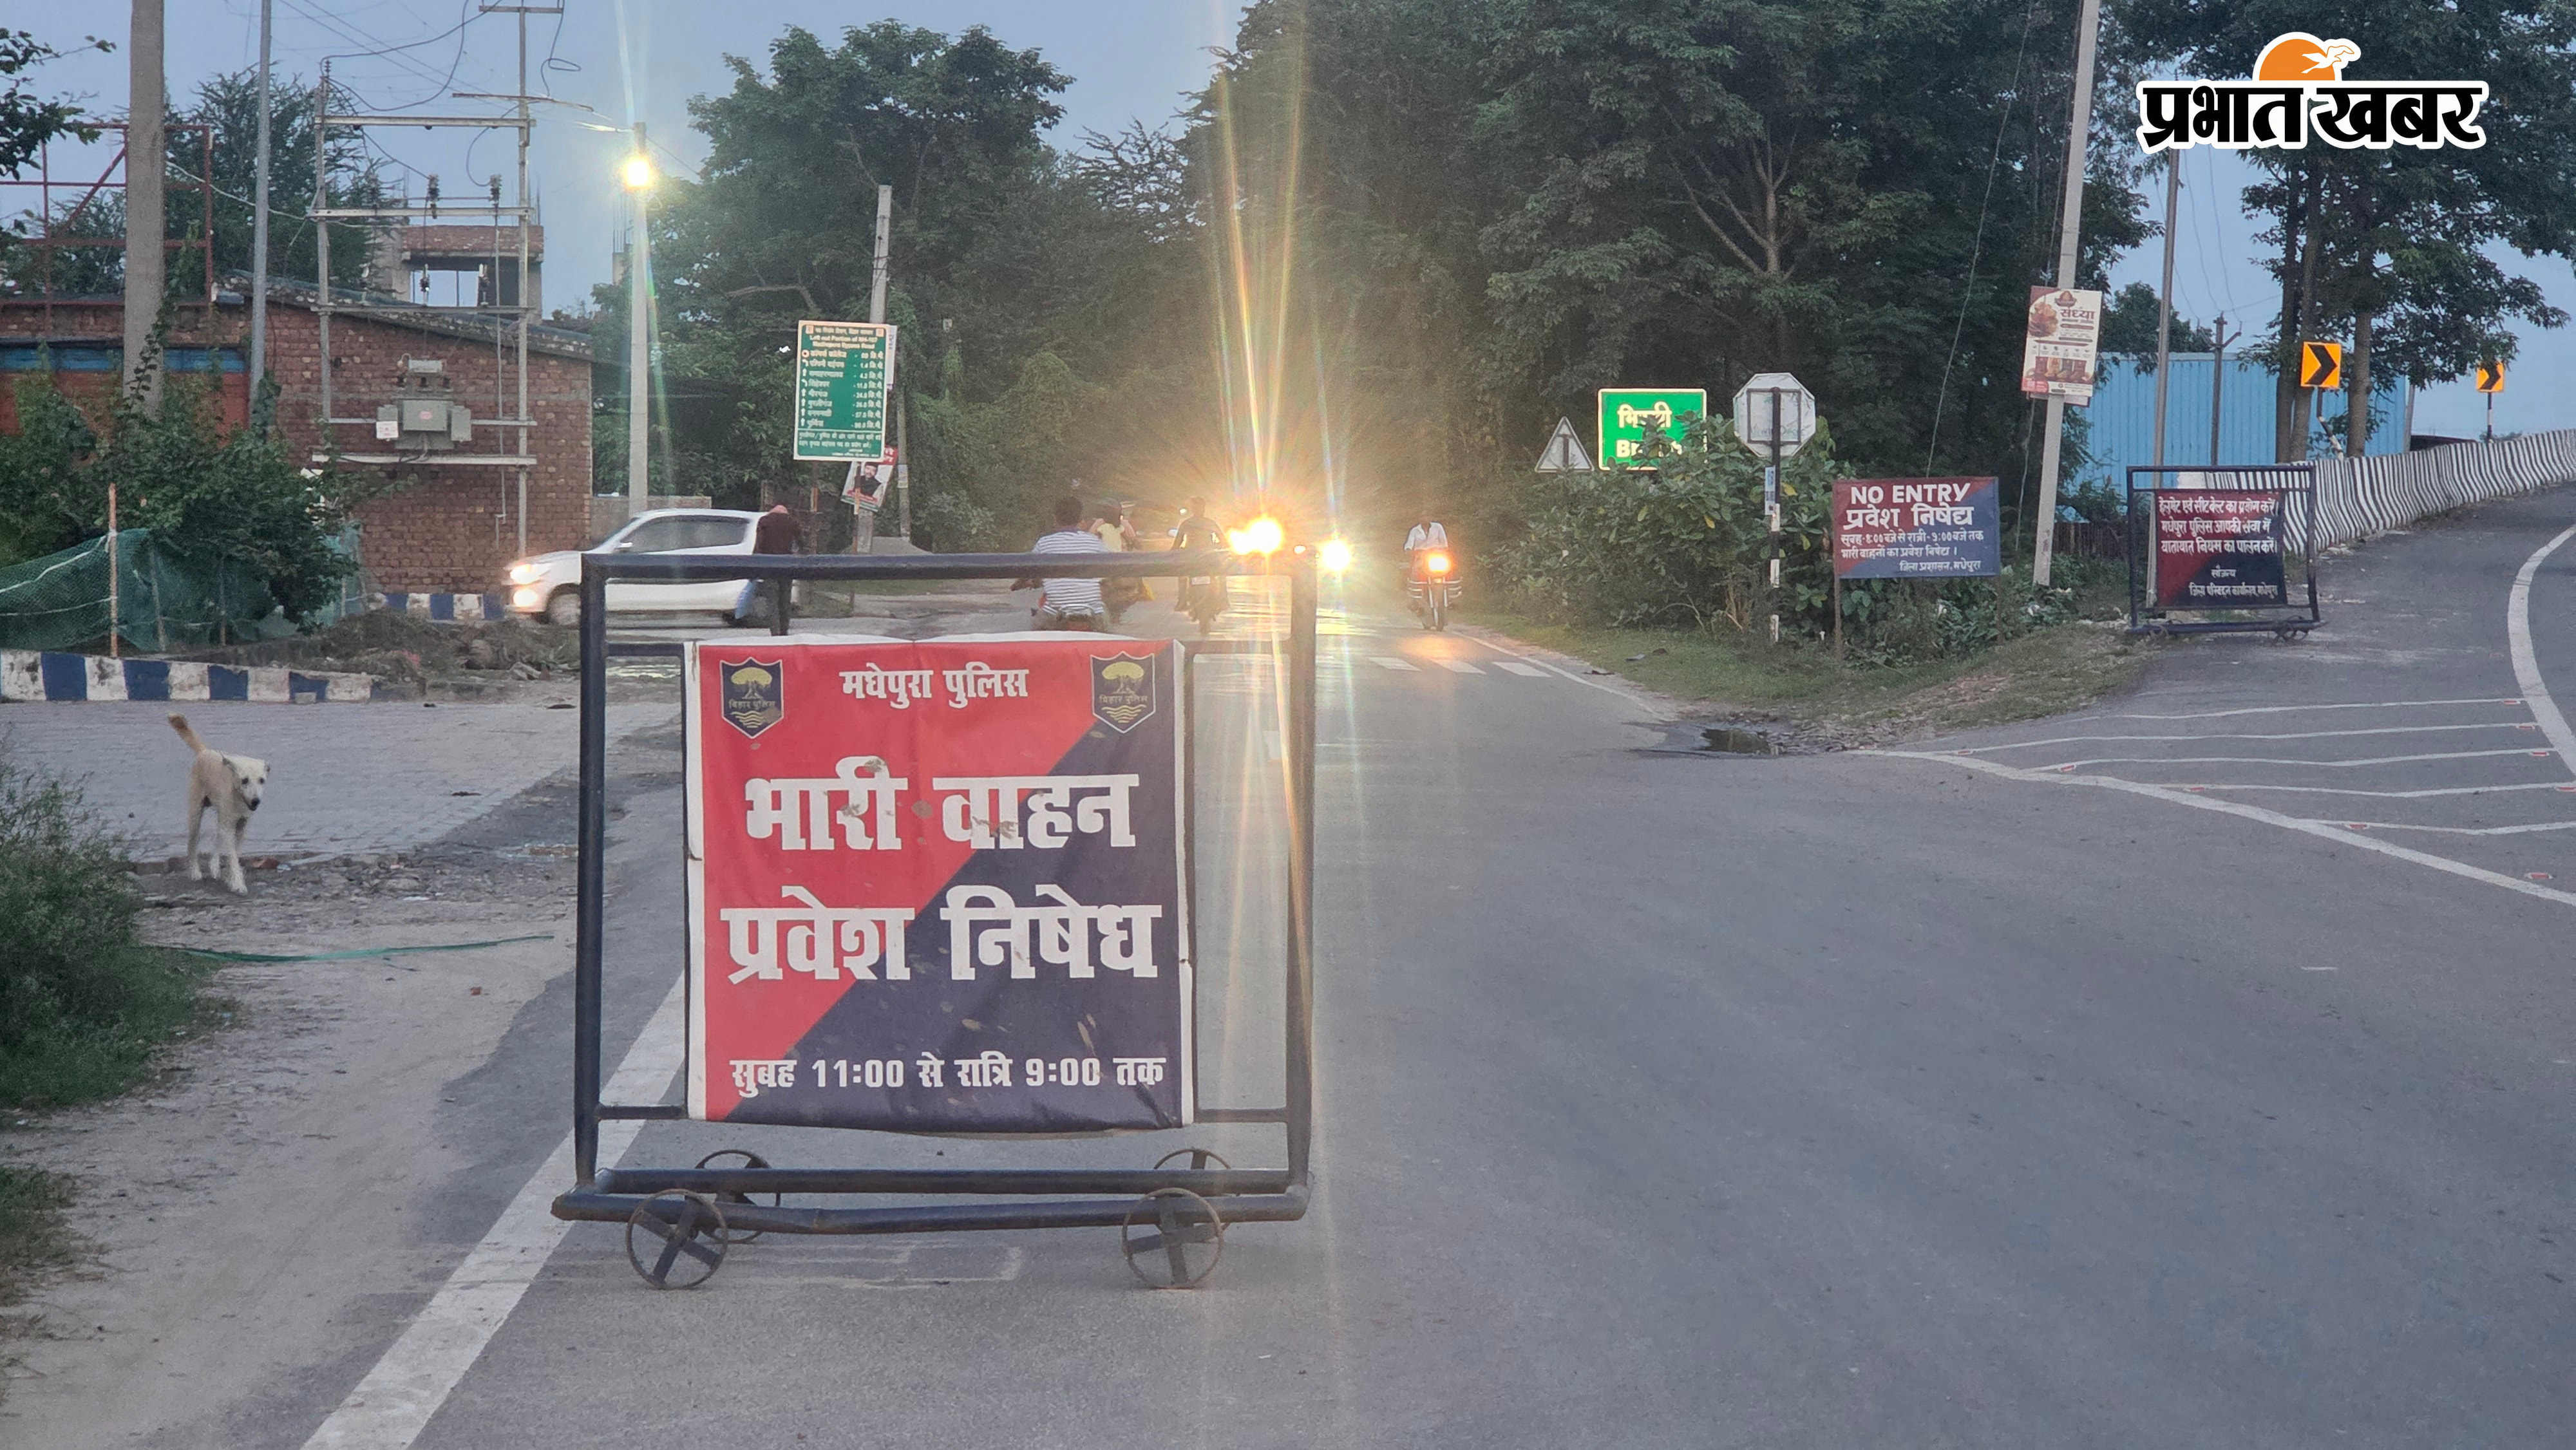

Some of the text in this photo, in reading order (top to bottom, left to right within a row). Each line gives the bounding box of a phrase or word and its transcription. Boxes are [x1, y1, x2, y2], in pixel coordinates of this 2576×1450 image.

[1851, 483, 1971, 505] NO ENTRY
[1843, 504, 1900, 530] प्रवेश
[2225, 500, 2237, 514] का
[1968, 531, 1984, 541] तक
[2160, 516, 2187, 538] मधेपुरा
[2188, 516, 2214, 537] पुलिस
[2214, 516, 2241, 534] आपकी
[2262, 517, 2272, 533] में
[1886, 547, 1899, 557] का
[1900, 543, 1924, 558] प्रवेश
[2195, 536, 2222, 553] नियम
[2224, 540, 2235, 552] का
[2236, 540, 2260, 555] पालन
[839, 661, 1029, 710] मधेपुरा पुलिस
[744, 755, 1139, 851] भारी वाहन
[720, 885, 1162, 985] प्रवेश निषेध
[729, 1051, 1167, 1098] सुबह 11:00 से रात्रि 9:00 तक
